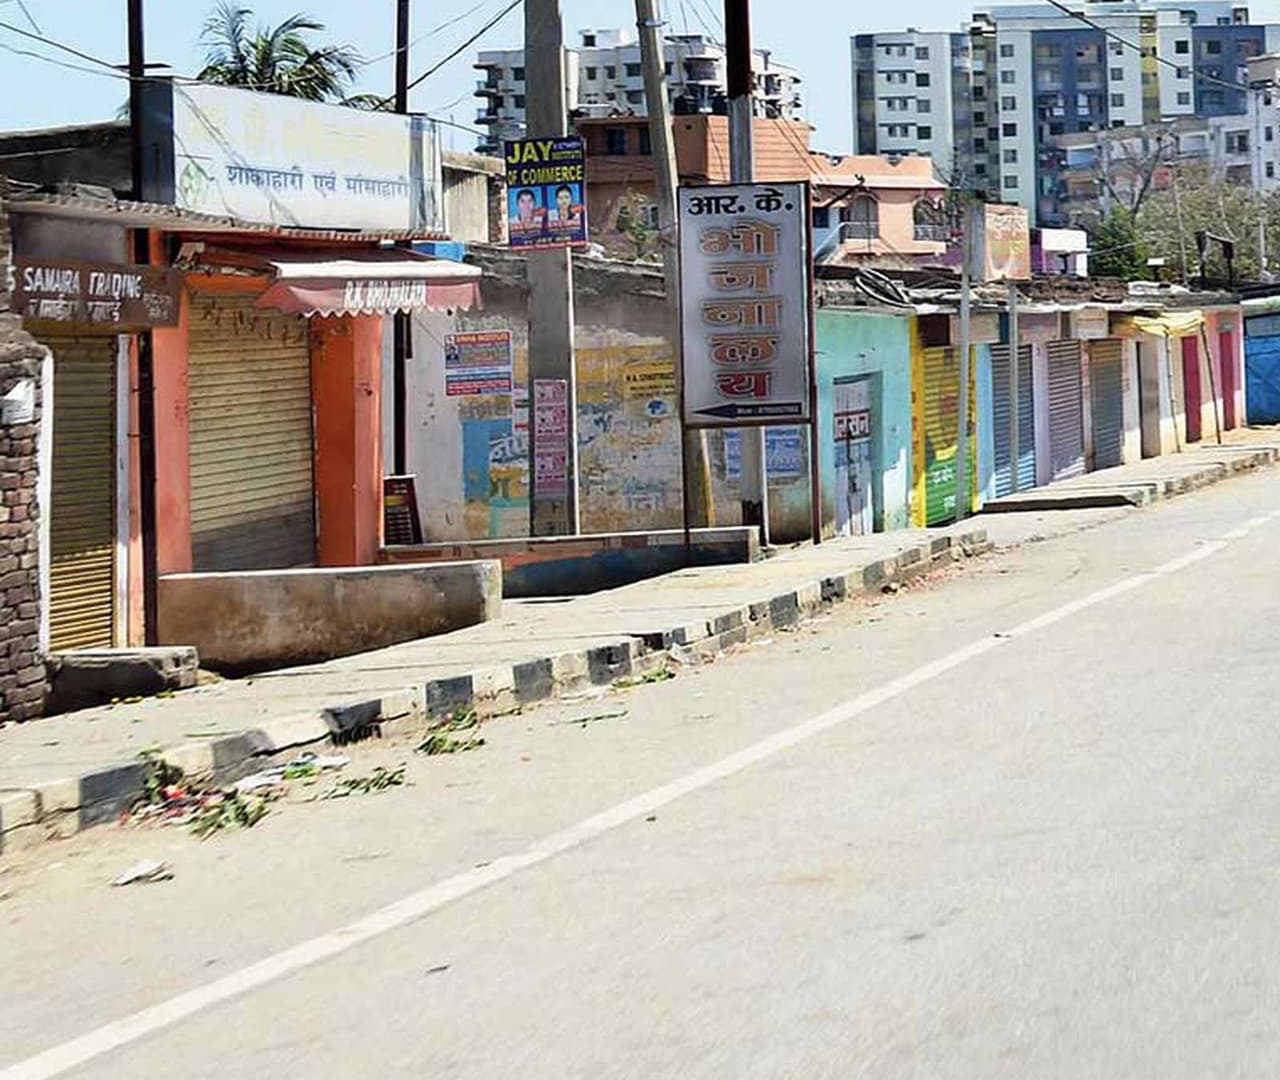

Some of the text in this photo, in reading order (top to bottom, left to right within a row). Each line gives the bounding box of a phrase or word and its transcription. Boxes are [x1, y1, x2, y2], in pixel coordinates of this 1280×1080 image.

[507, 141, 553, 164] JAY
[226, 165, 304, 192] शाकाहारी
[313, 170, 336, 198] एवं
[508, 165, 583, 185] OF COMMERCE
[688, 188, 793, 216] आर. के.
